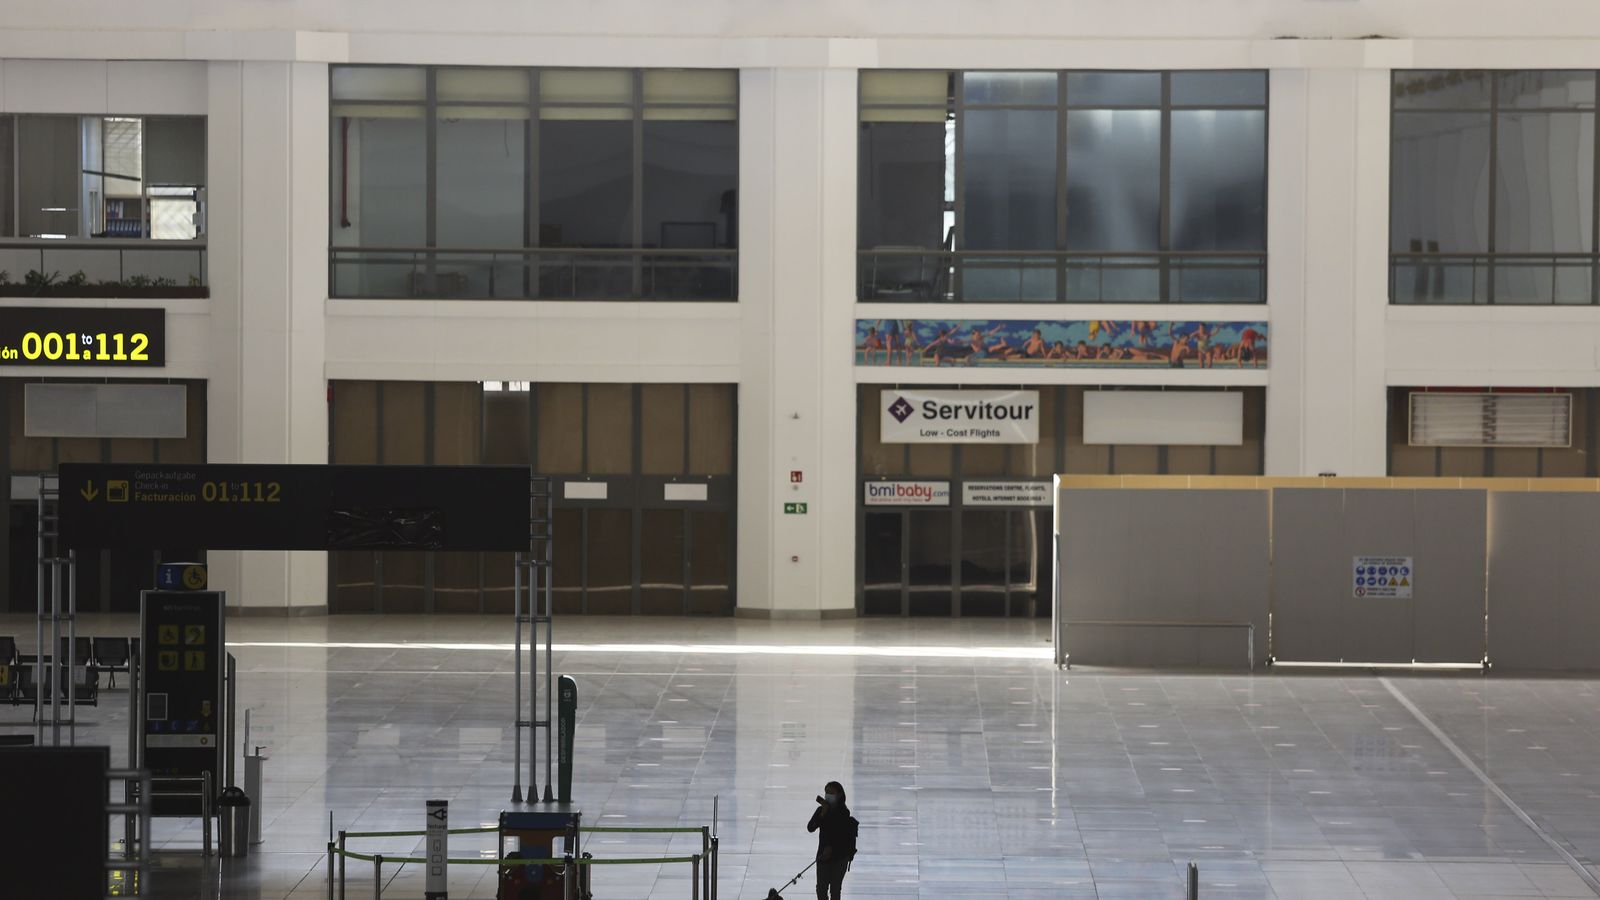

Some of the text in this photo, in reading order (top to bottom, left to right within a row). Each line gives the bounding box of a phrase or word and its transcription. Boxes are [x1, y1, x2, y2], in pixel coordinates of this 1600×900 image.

[0, 332, 149, 361] ón 001 to a 112
[922, 400, 1033, 420] Servitour
[920, 429, 938, 437] Low
[946, 428, 968, 437] Cost
[970, 428, 1000, 438] Flights
[134, 480, 169, 490] Check-in
[134, 490, 197, 502] Facturación
[202, 481, 229, 502] 01
[240, 481, 281, 502] 112
